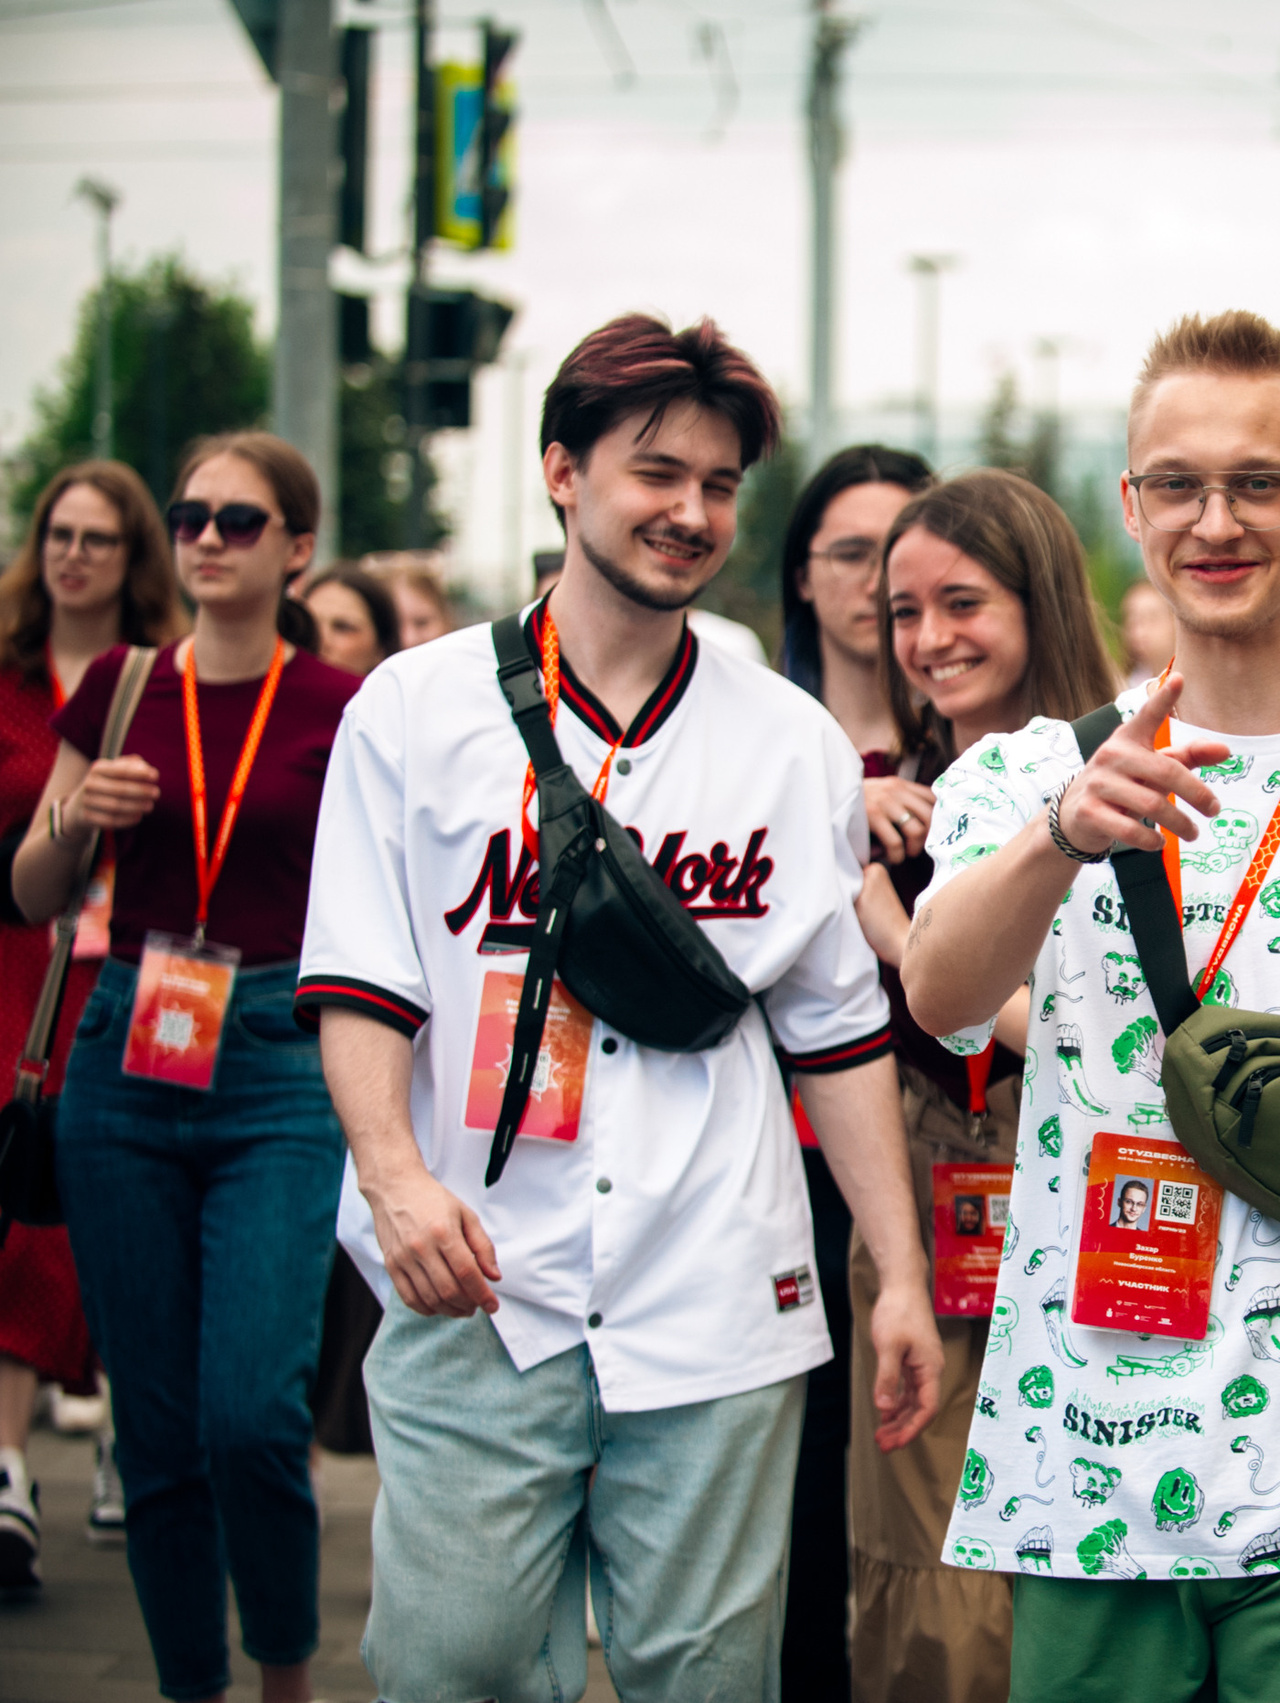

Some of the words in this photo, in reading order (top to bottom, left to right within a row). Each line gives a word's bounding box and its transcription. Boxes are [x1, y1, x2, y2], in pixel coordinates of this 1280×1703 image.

[444, 828, 539, 936] Ne
[1118, 1147, 1195, 1164] СТУДВЕСНА
[1118, 1279, 1170, 1293] УЧАСТНИК
[1063, 1402, 1201, 1447] SINISTER
